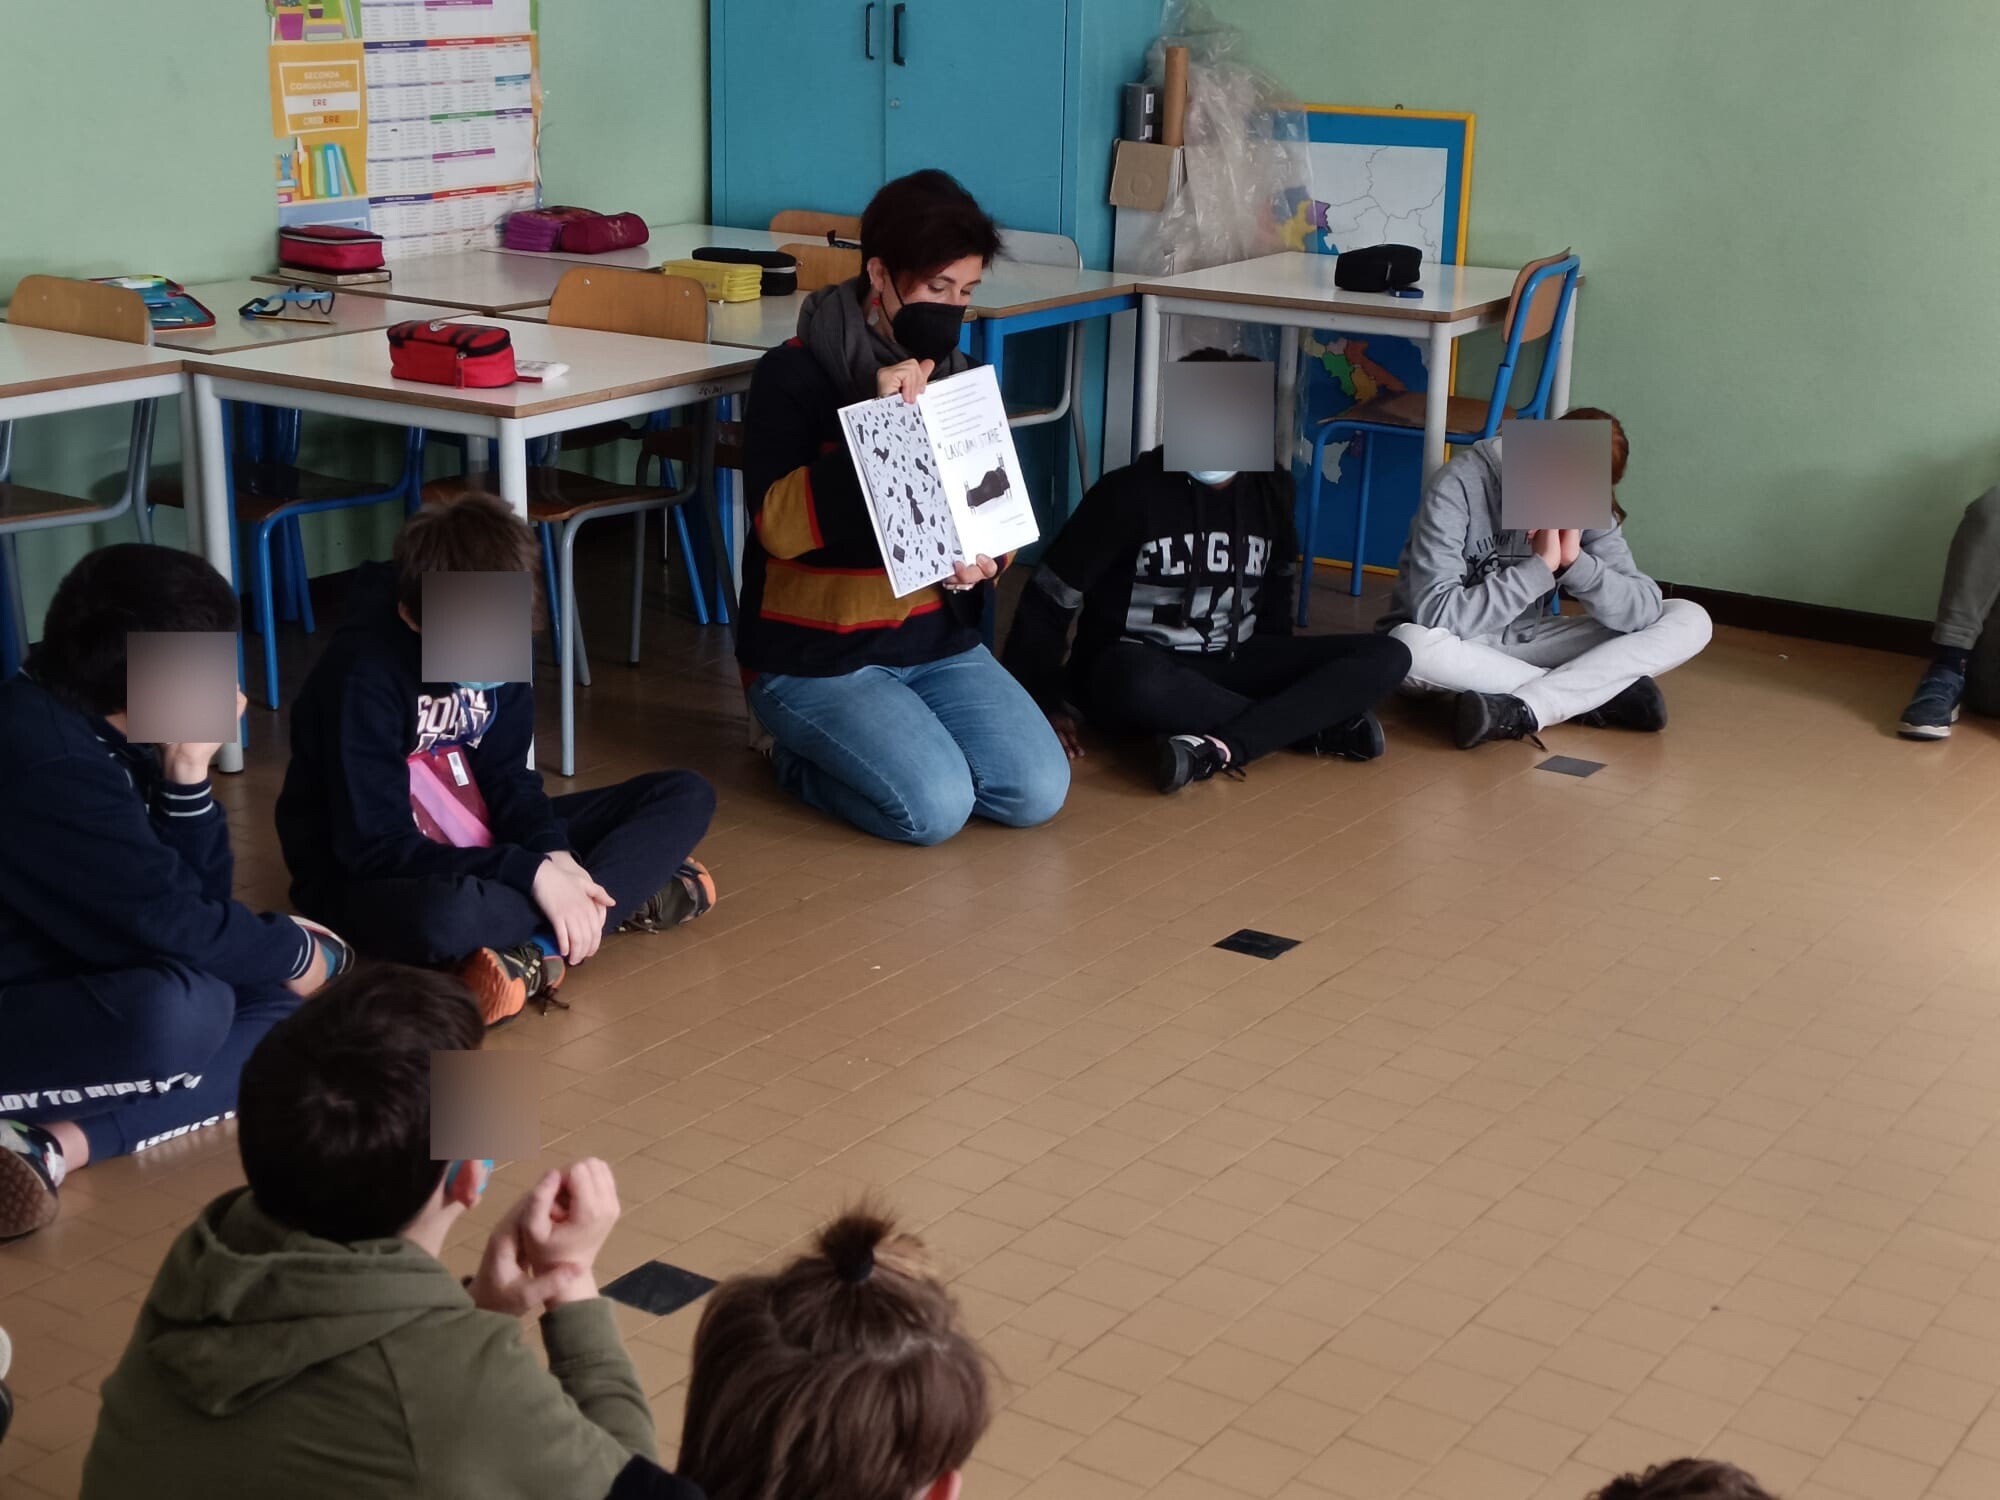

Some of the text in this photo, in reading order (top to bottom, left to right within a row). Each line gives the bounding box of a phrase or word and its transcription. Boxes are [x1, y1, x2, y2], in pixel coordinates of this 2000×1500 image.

[312, 98, 327, 107] ERE
[1136, 531, 1272, 576] FLGR
[42, 1089, 82, 1105] TO
[84, 1079, 152, 1098] RIDE
